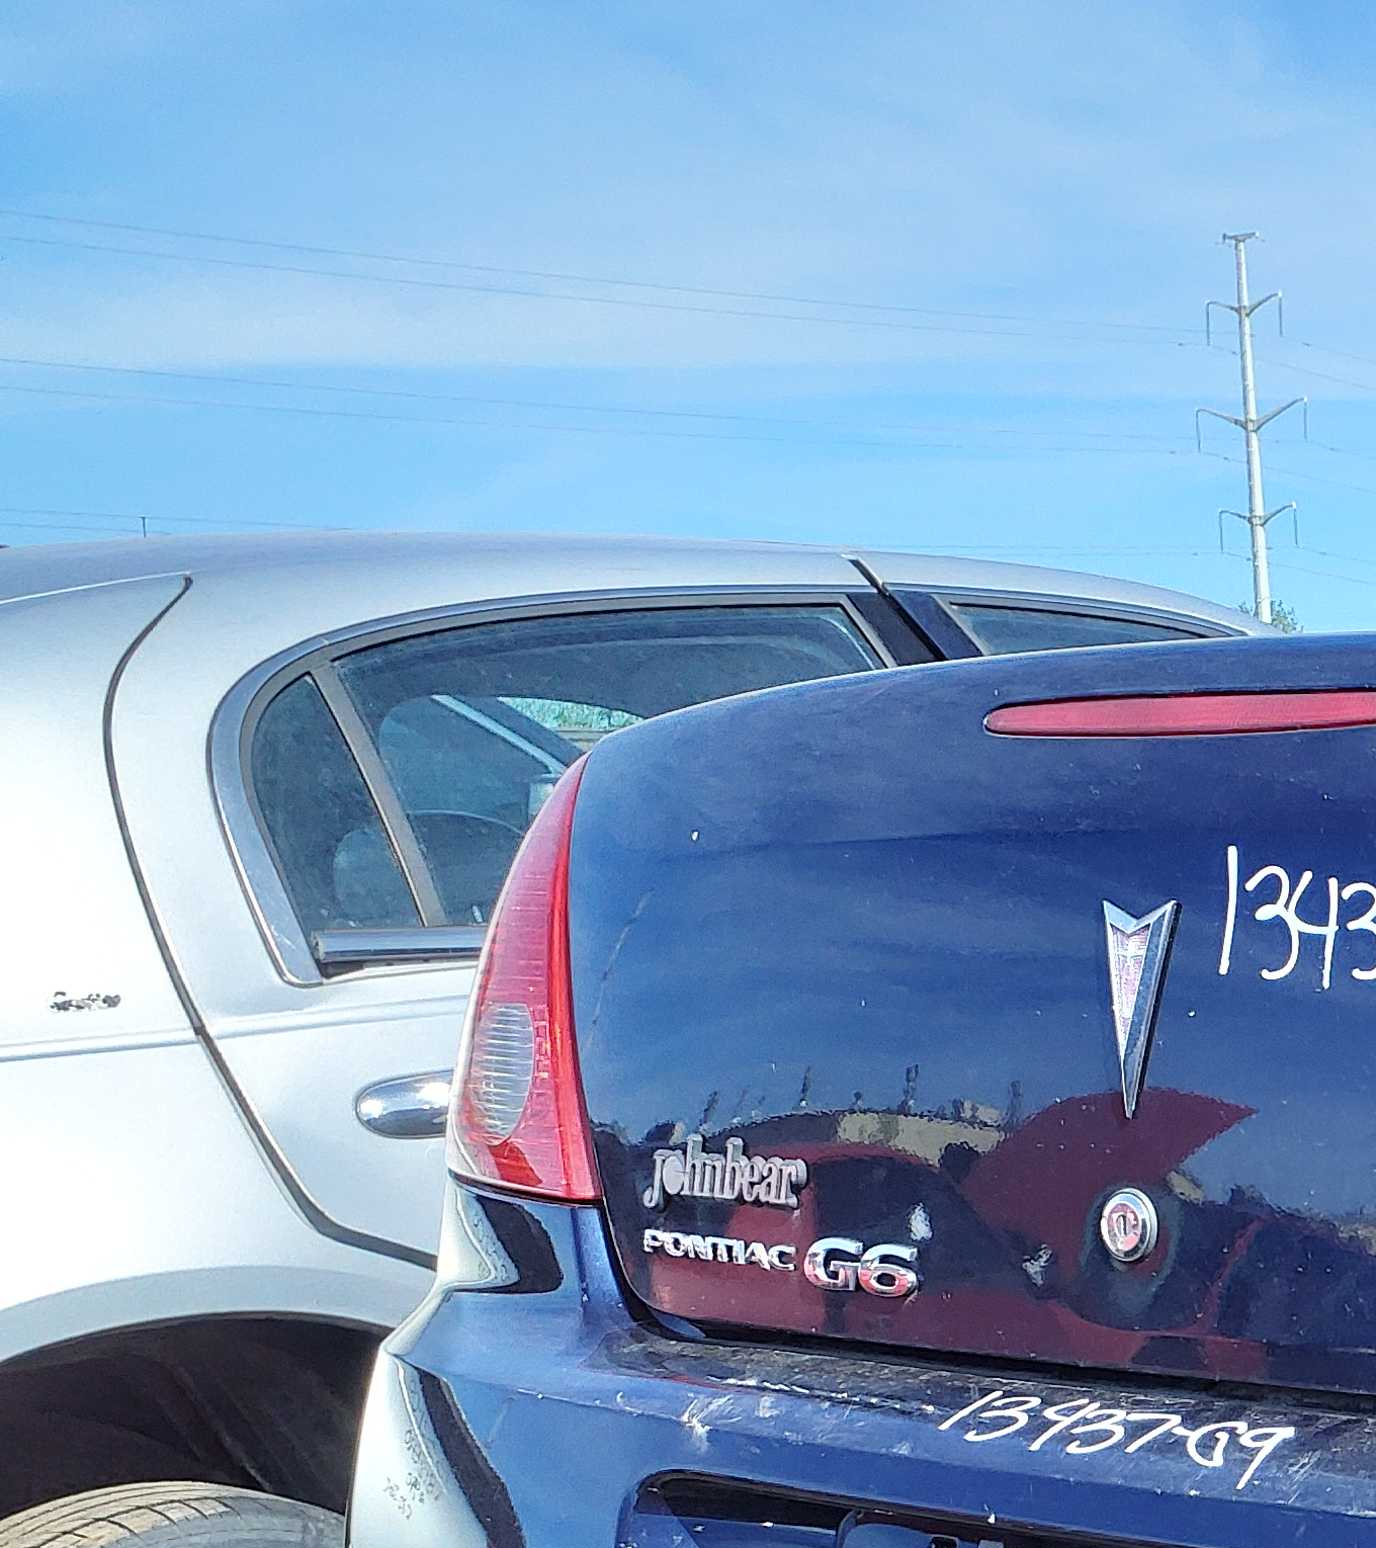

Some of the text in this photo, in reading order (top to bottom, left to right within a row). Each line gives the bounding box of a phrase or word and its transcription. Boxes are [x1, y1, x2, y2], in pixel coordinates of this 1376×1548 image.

[642, 1133, 808, 1209] johnbear
[642, 1228, 920, 1298] PONTIAC G6
[937, 1389, 1296, 1491] 13437-09
